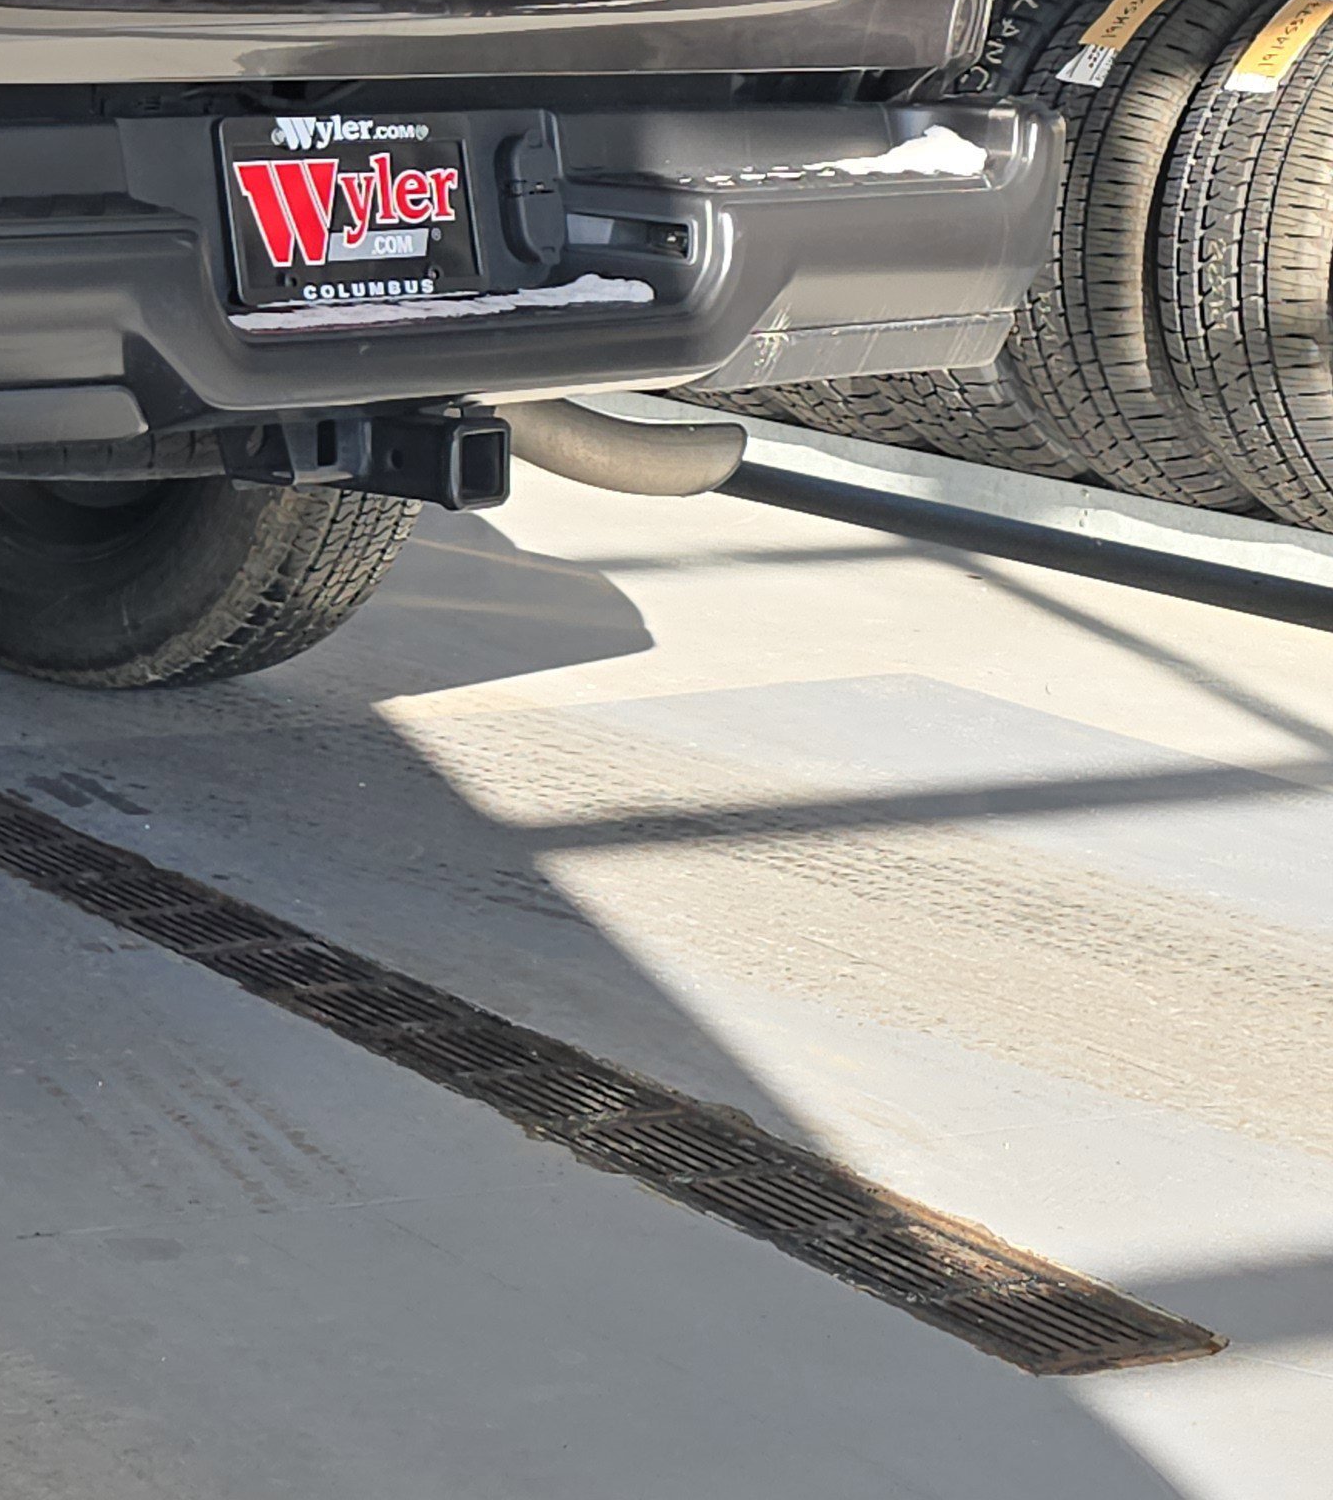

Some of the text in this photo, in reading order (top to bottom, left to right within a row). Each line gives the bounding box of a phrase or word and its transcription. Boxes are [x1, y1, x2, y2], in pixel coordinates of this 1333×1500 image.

[234, 153, 458, 267] Wyler
[371, 235, 413, 255] .COM
[302, 278, 434, 300] COLUMBUS
